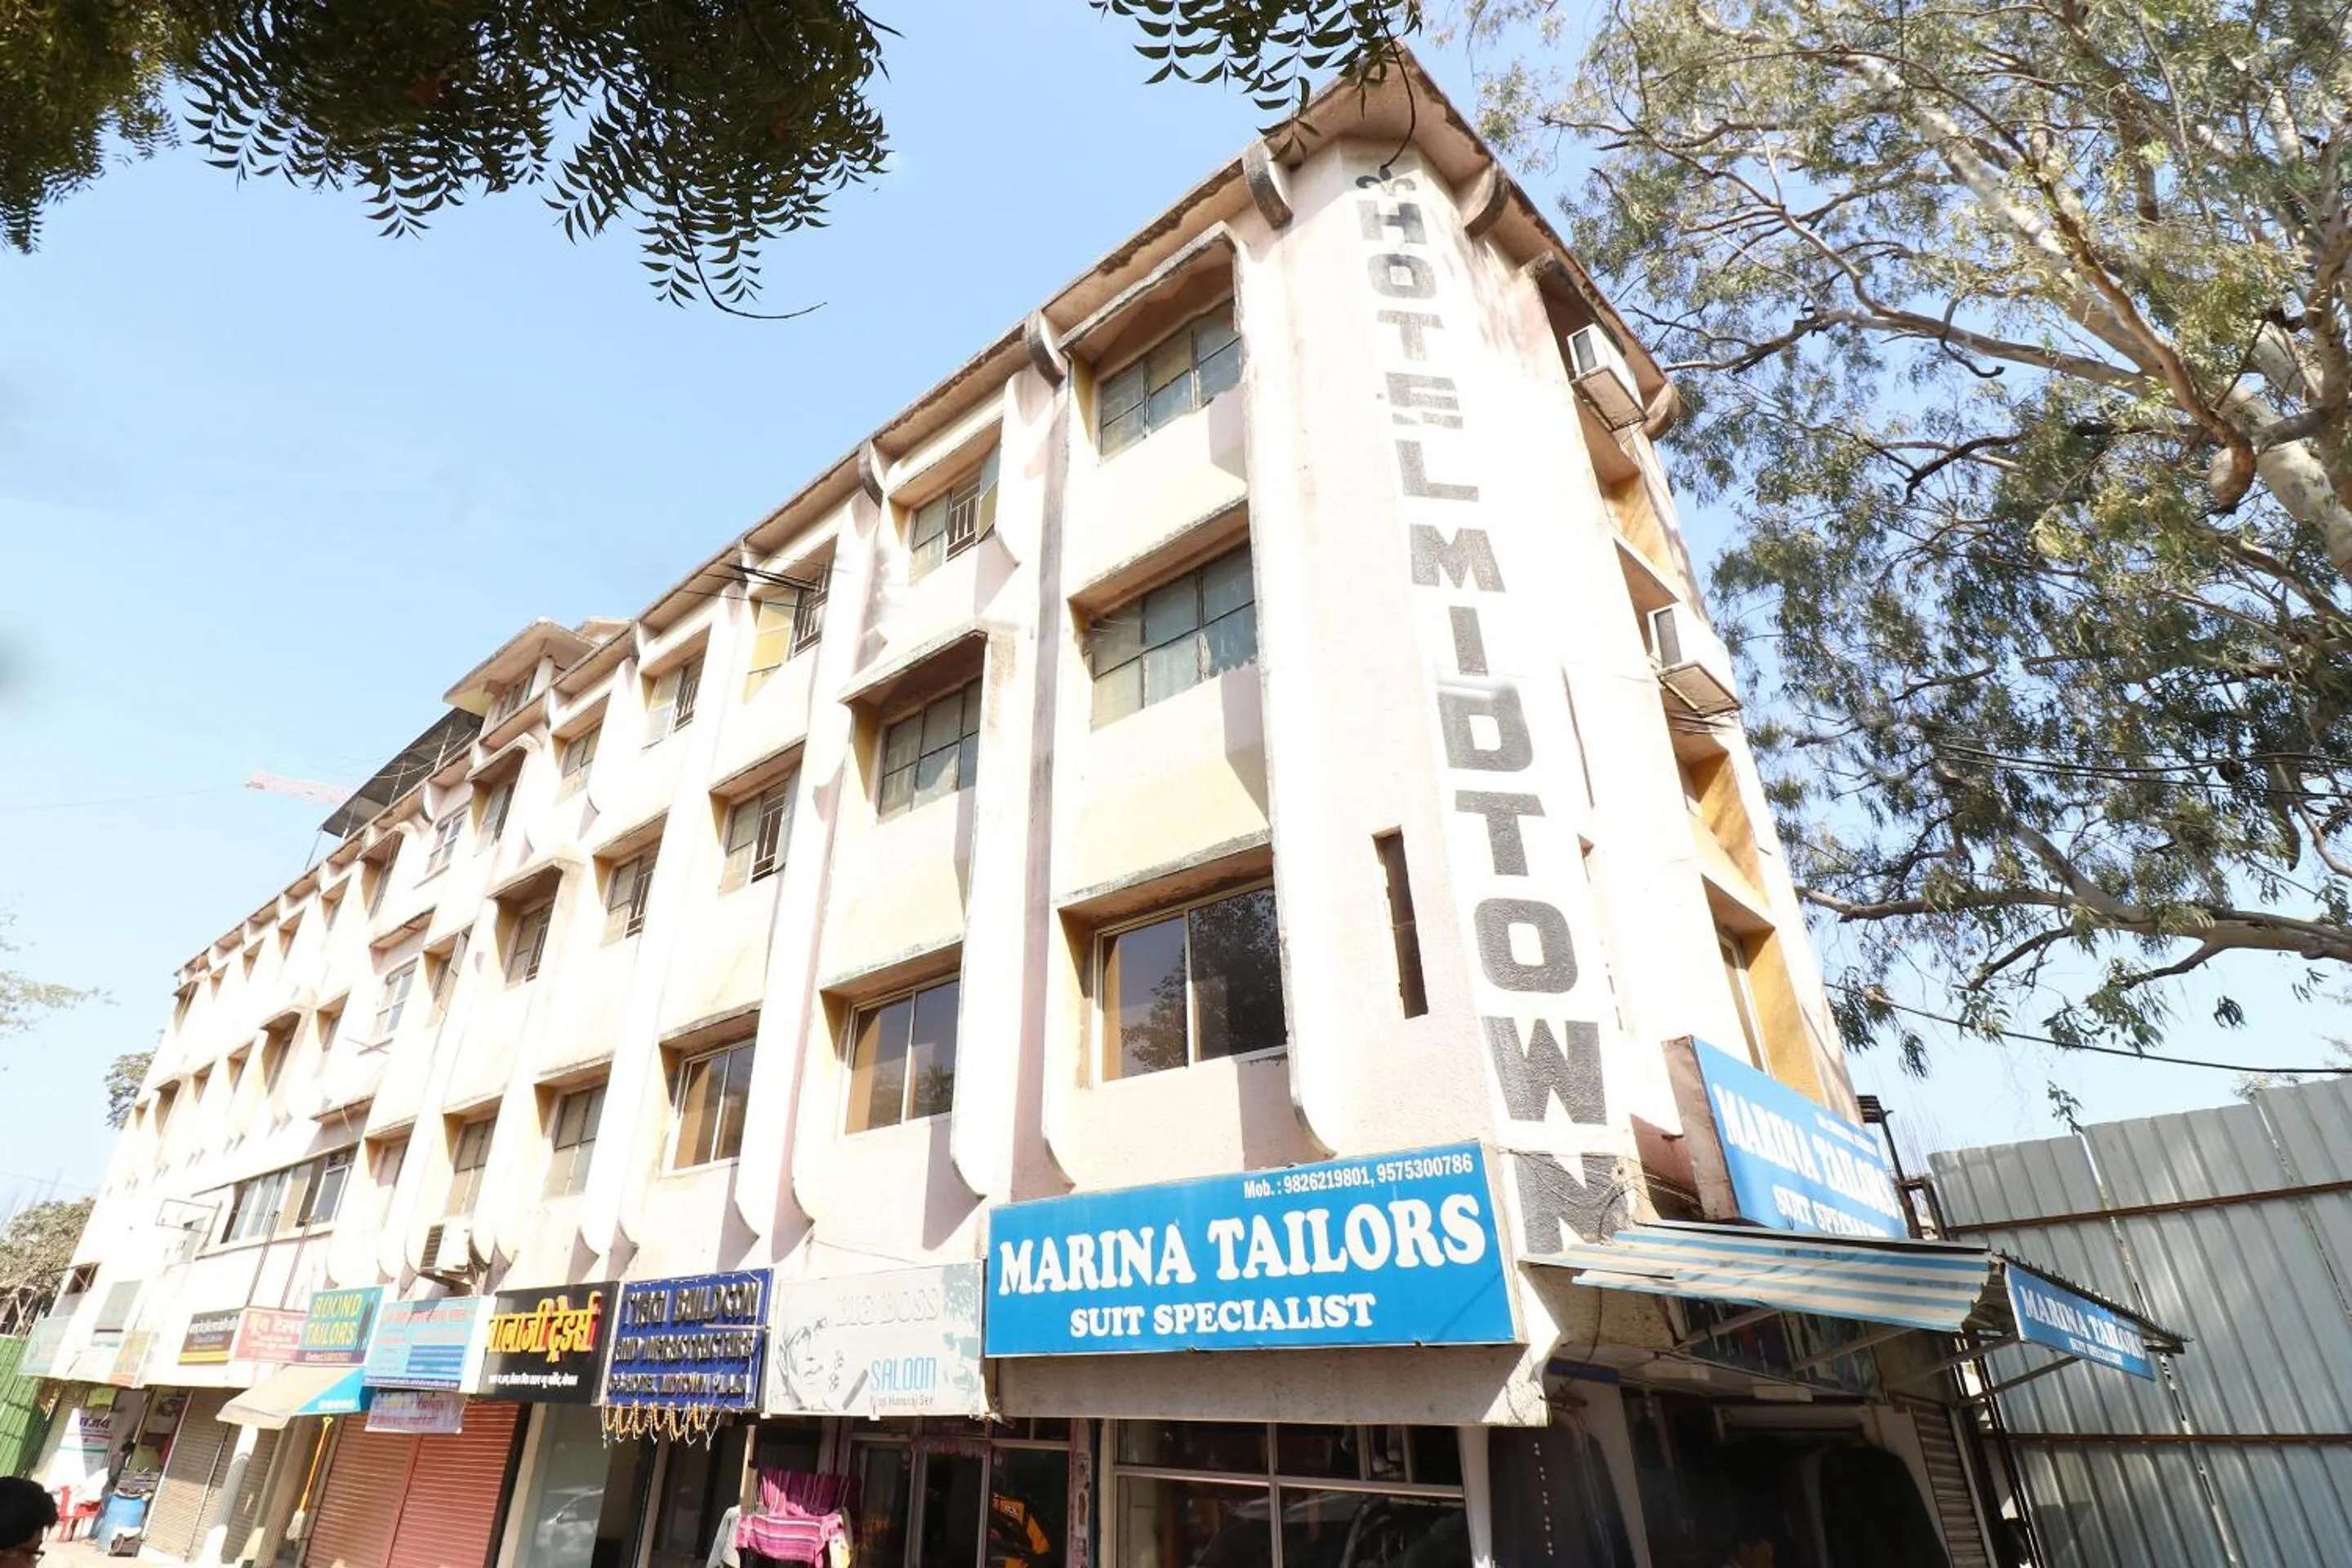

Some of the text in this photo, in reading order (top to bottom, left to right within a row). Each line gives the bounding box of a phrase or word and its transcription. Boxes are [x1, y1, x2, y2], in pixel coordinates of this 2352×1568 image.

[1356, 199, 1633, 1254] HOTEL MIDTOWN
[1713, 1082, 1823, 1184] MARINA
[1377, 1153, 1472, 1183] 9575300786
[1772, 1183, 1815, 1227] SUIT
[998, 1193, 1486, 1296] MARINA TAILORS
[1071, 1293, 1376, 1338] SUIT SPECIALIST
[2019, 1285, 2146, 1360] MARINA TAILORS
[871, 1356, 937, 1392] SALOON
